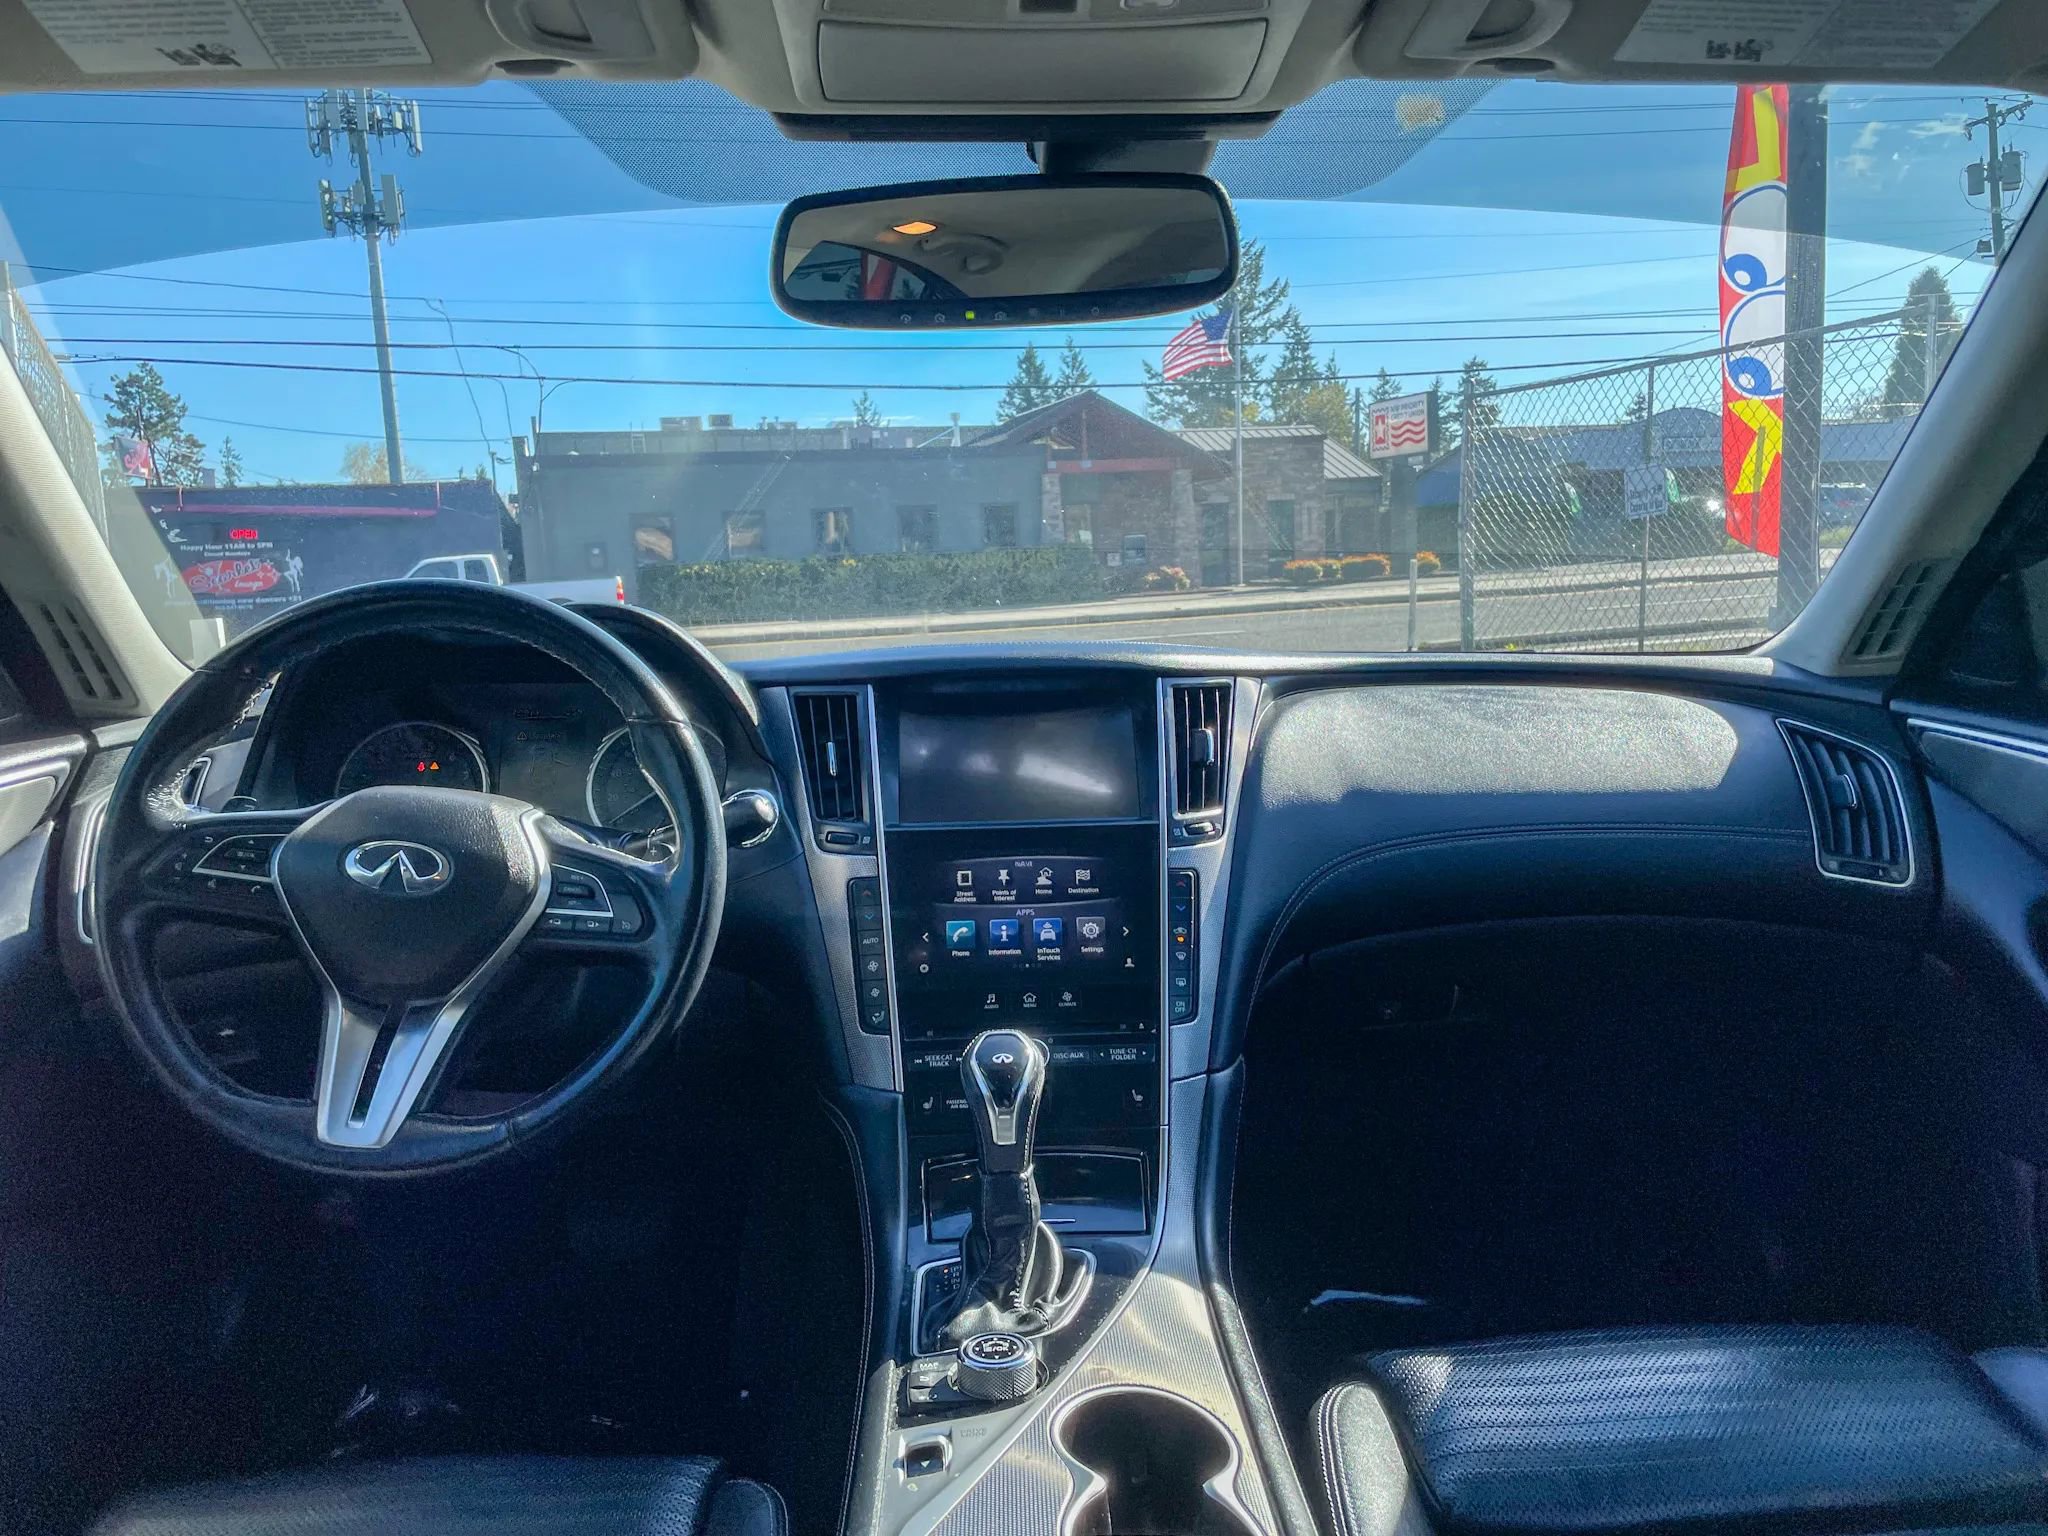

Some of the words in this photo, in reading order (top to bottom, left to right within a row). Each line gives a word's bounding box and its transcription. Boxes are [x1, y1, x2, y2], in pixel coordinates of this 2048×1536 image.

[230, 529, 258, 540] OPEN
[180, 544, 203, 552] Happy
[224, 542, 245, 550] 11AM
[247, 541, 255, 549] to
[234, 580, 264, 591] Lounge
[1010, 888, 1017, 896] of
[1015, 908, 1035, 916] APPS
[862, 937, 879, 945] AUTO
[988, 948, 1022, 956] Information
[1037, 953, 1061, 961] Services
[1111, 1053, 1137, 1061] FOLDER
